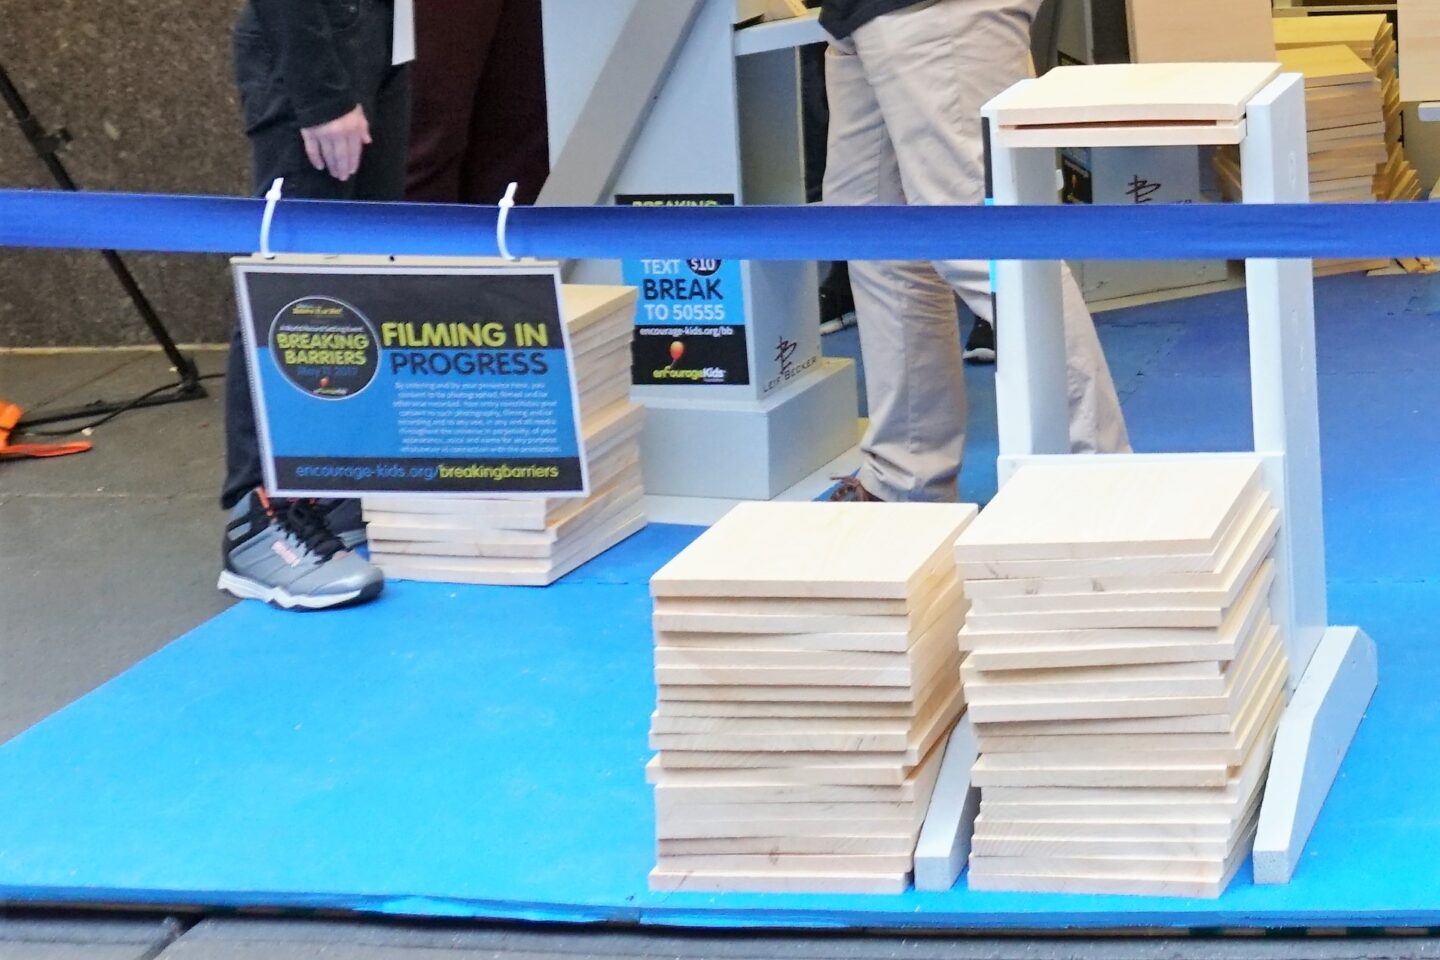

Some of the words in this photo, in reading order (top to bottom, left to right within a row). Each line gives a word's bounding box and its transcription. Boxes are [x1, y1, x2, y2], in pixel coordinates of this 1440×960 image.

[641, 259, 680, 275] TEXT
[643, 278, 724, 300] BREAK
[643, 304, 668, 321] TO
[672, 304, 725, 321] 50555
[381, 321, 507, 348] FILMING
[514, 322, 549, 348] IN
[639, 326, 733, 338] encourage-kids.org/bb
[276, 332, 369, 350] BREAKING
[285, 349, 367, 366] BARRIERS
[391, 352, 549, 376] PROGRESS
[296, 464, 559, 481] encourage-kids.org/breakingbarriers
